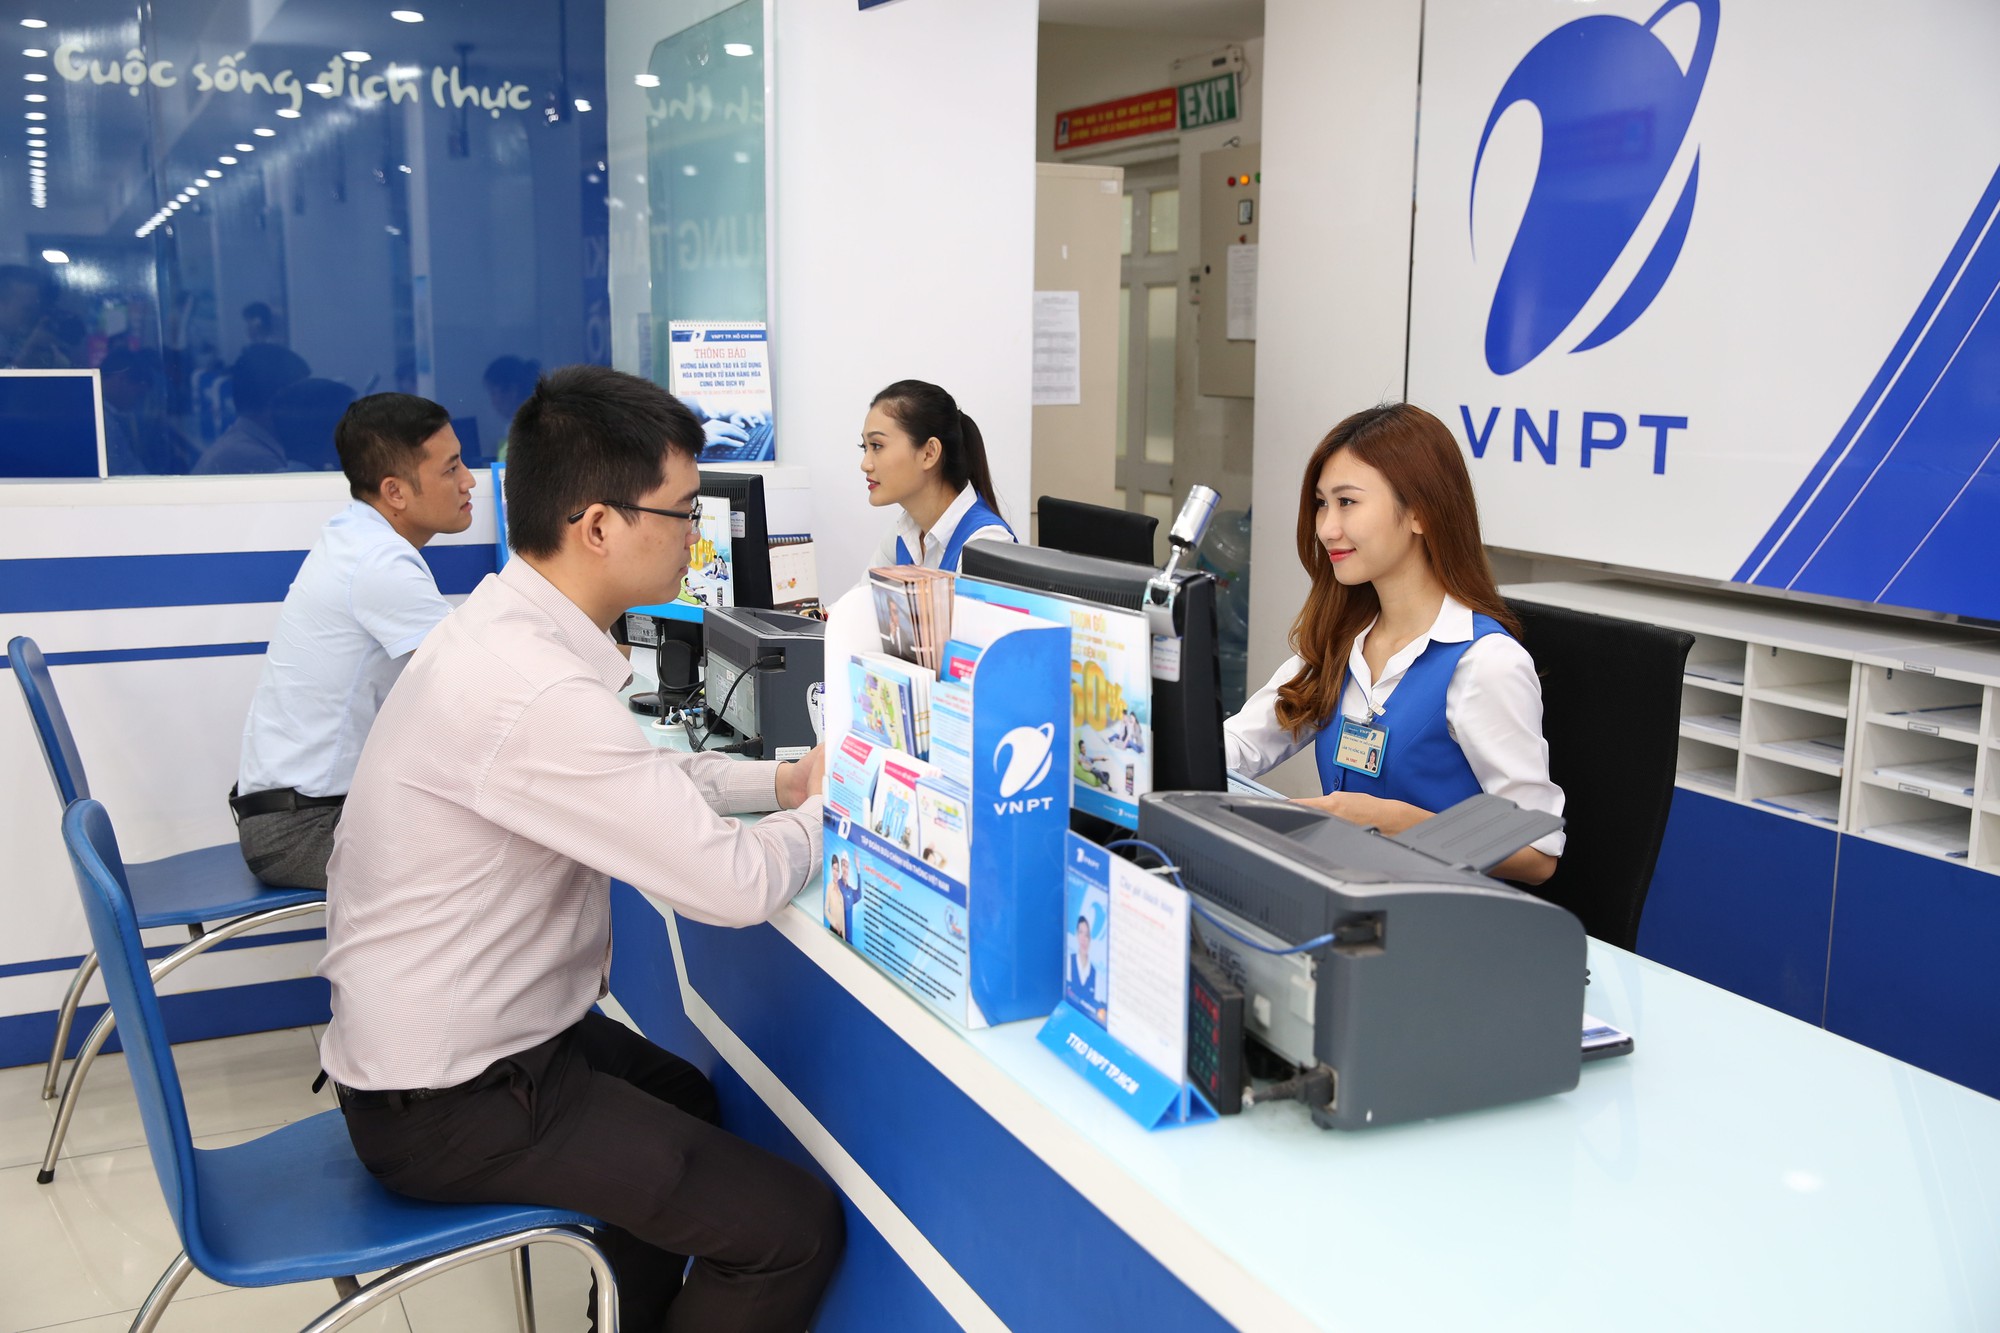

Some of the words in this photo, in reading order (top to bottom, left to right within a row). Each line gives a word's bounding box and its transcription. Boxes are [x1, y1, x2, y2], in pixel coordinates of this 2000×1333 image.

[192, 51, 303, 112] sống
[431, 66, 531, 119] thực
[1183, 77, 1230, 127] EXIT
[694, 346, 725, 359] THÔNG
[1459, 404, 1688, 475] VNPT
[993, 797, 1053, 816] VNPT
[1085, 1047, 1110, 1071] VNPT
